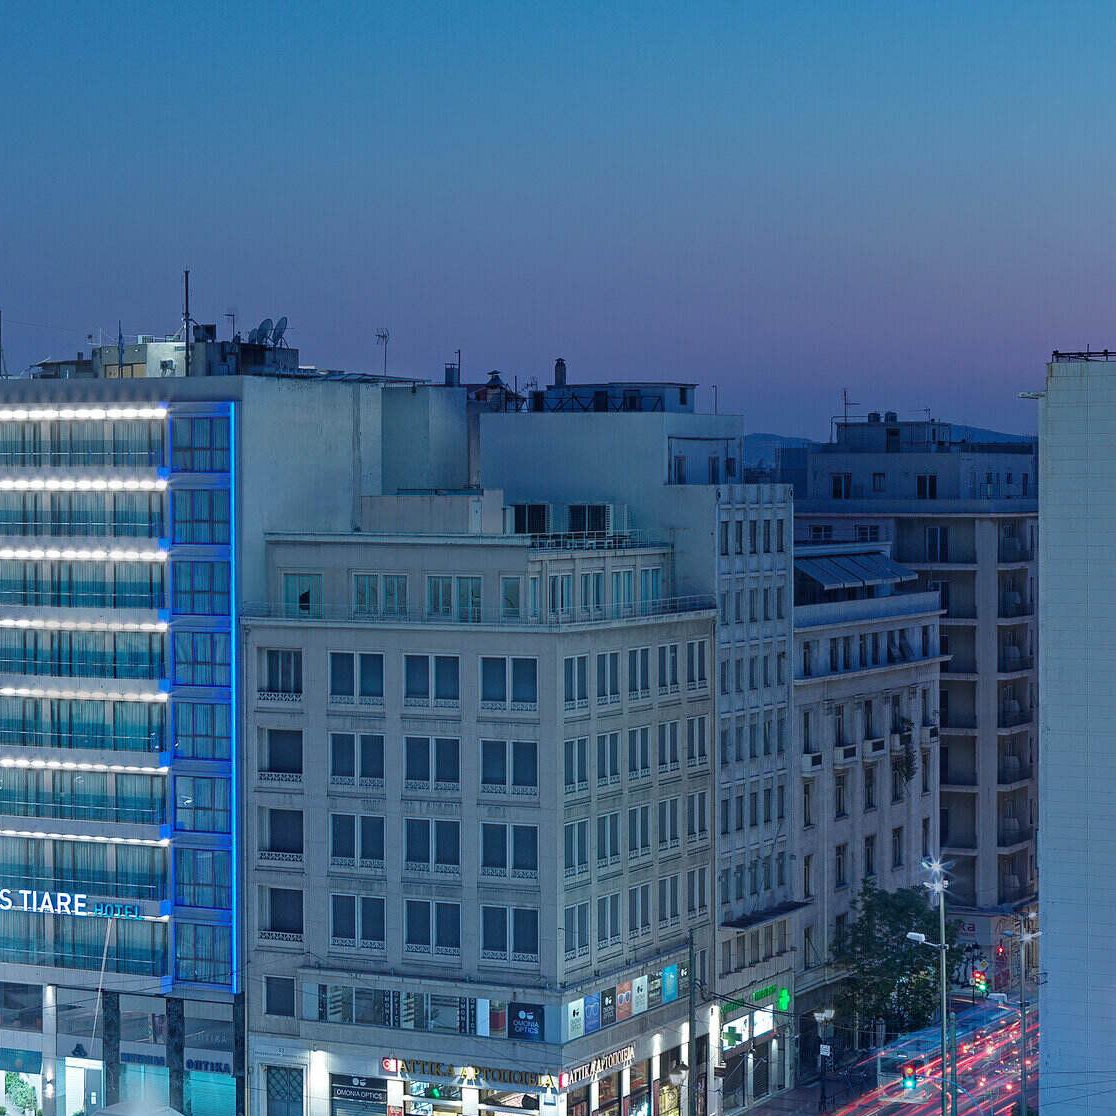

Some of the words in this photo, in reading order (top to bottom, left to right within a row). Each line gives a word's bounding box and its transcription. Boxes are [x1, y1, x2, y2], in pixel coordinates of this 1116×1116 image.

[19, 890, 87, 916] TIARE
[93, 902, 145, 921] HOTEL
[513, 1019, 539, 1028] OMONIA
[514, 1026, 539, 1034] OPTICS
[336, 1088, 360, 1098] OMONIA
[361, 1090, 383, 1100] OPTICS
